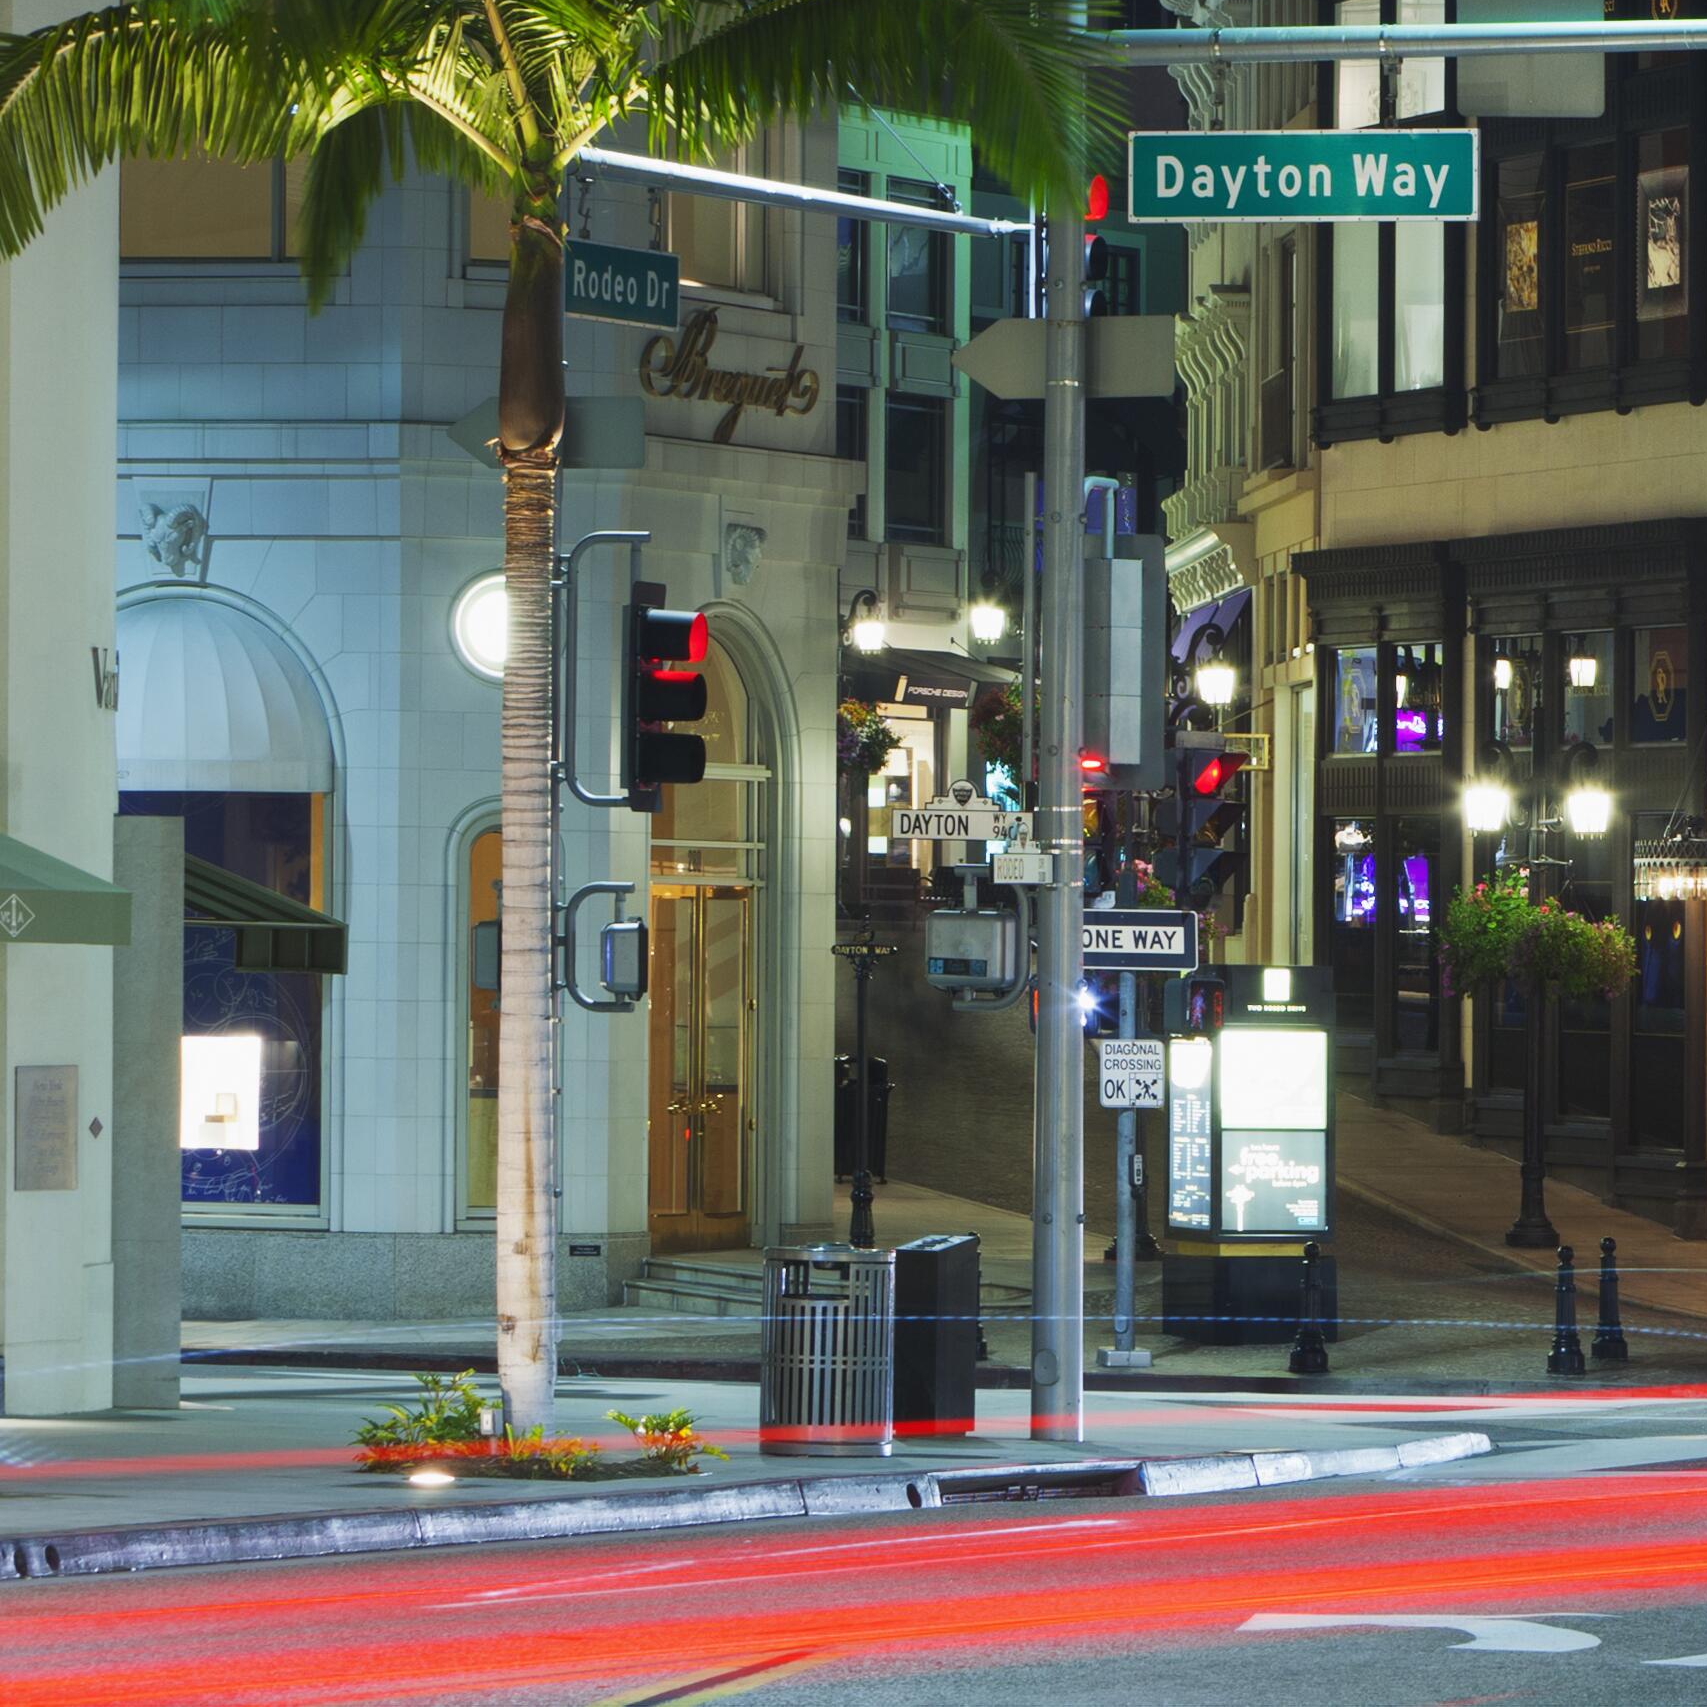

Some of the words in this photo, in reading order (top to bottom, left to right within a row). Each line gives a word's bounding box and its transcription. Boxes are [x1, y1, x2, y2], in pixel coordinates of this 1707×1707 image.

[1156, 154, 1332, 209] Dayton
[1352, 153, 1450, 209] Way
[573, 259, 638, 306] Rodeo
[646, 270, 670, 310] Dr
[640, 306, 819, 443] Breguet
[908, 686, 942, 697] PORSCHE
[942, 689, 969, 699] DESIGN
[900, 813, 969, 836] DAYTON
[993, 813, 1007, 824] WY
[997, 858, 1024, 880] RODEO
[1083, 929, 1123, 949] ONE
[1132, 930, 1177, 950] WAY
[834, 946, 868, 955] DAYTON
[1104, 1043, 1160, 1056] DIAGONAL
[1104, 1059, 1162, 1071] CROSSING
[1104, 1079, 1126, 1099] OK
[1240, 1147, 1280, 1166] free
[1245, 1160, 1320, 1184] parking
